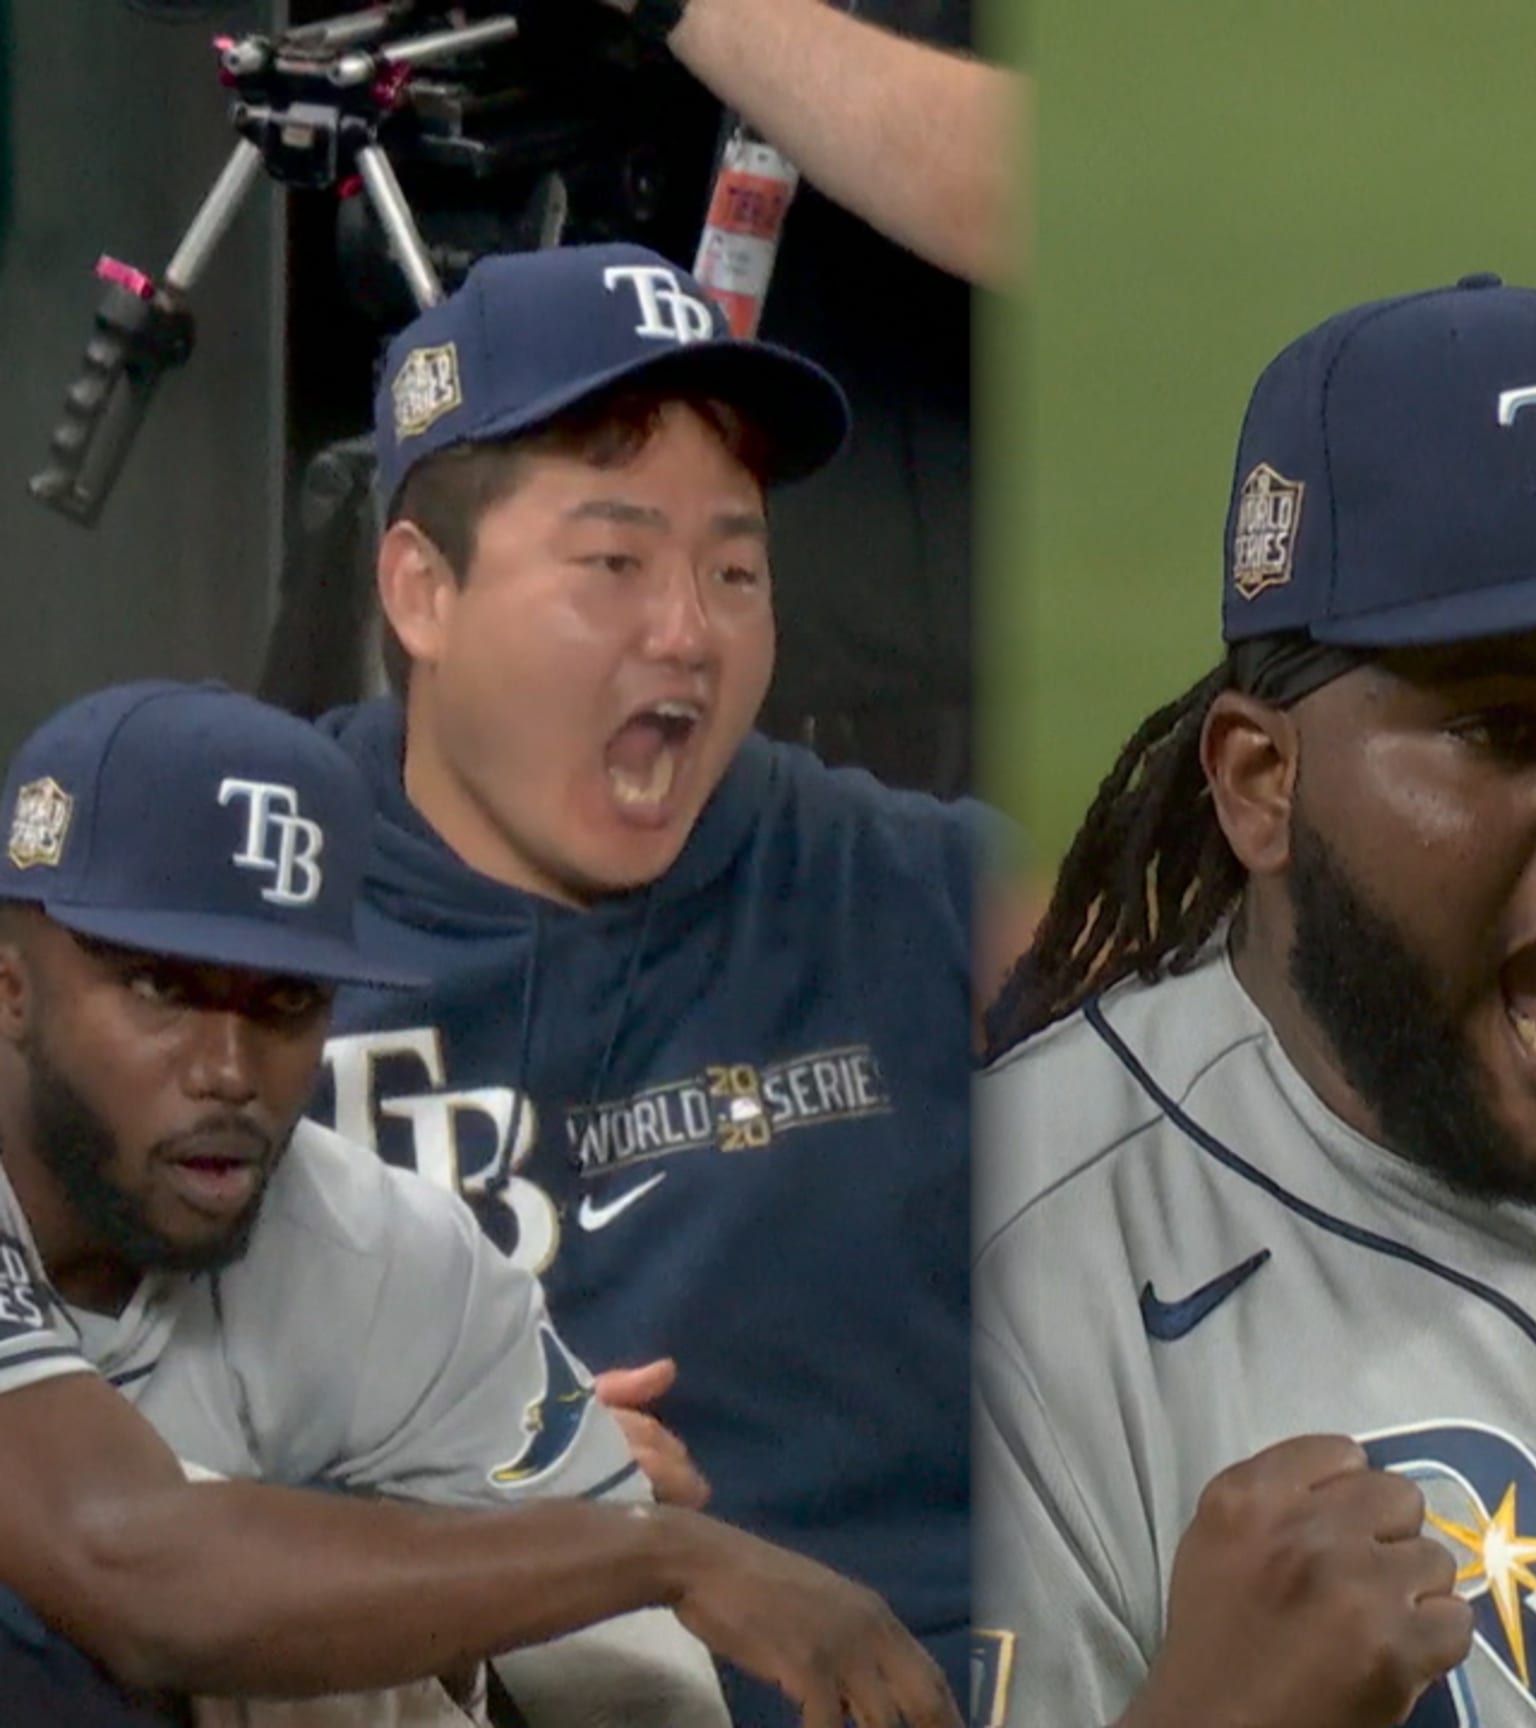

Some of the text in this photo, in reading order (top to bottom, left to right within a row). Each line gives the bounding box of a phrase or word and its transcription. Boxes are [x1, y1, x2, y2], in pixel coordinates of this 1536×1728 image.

[217, 777, 324, 909] TB
[764, 1054, 886, 1123] SERIE
[566, 1089, 713, 1166] WORLD
